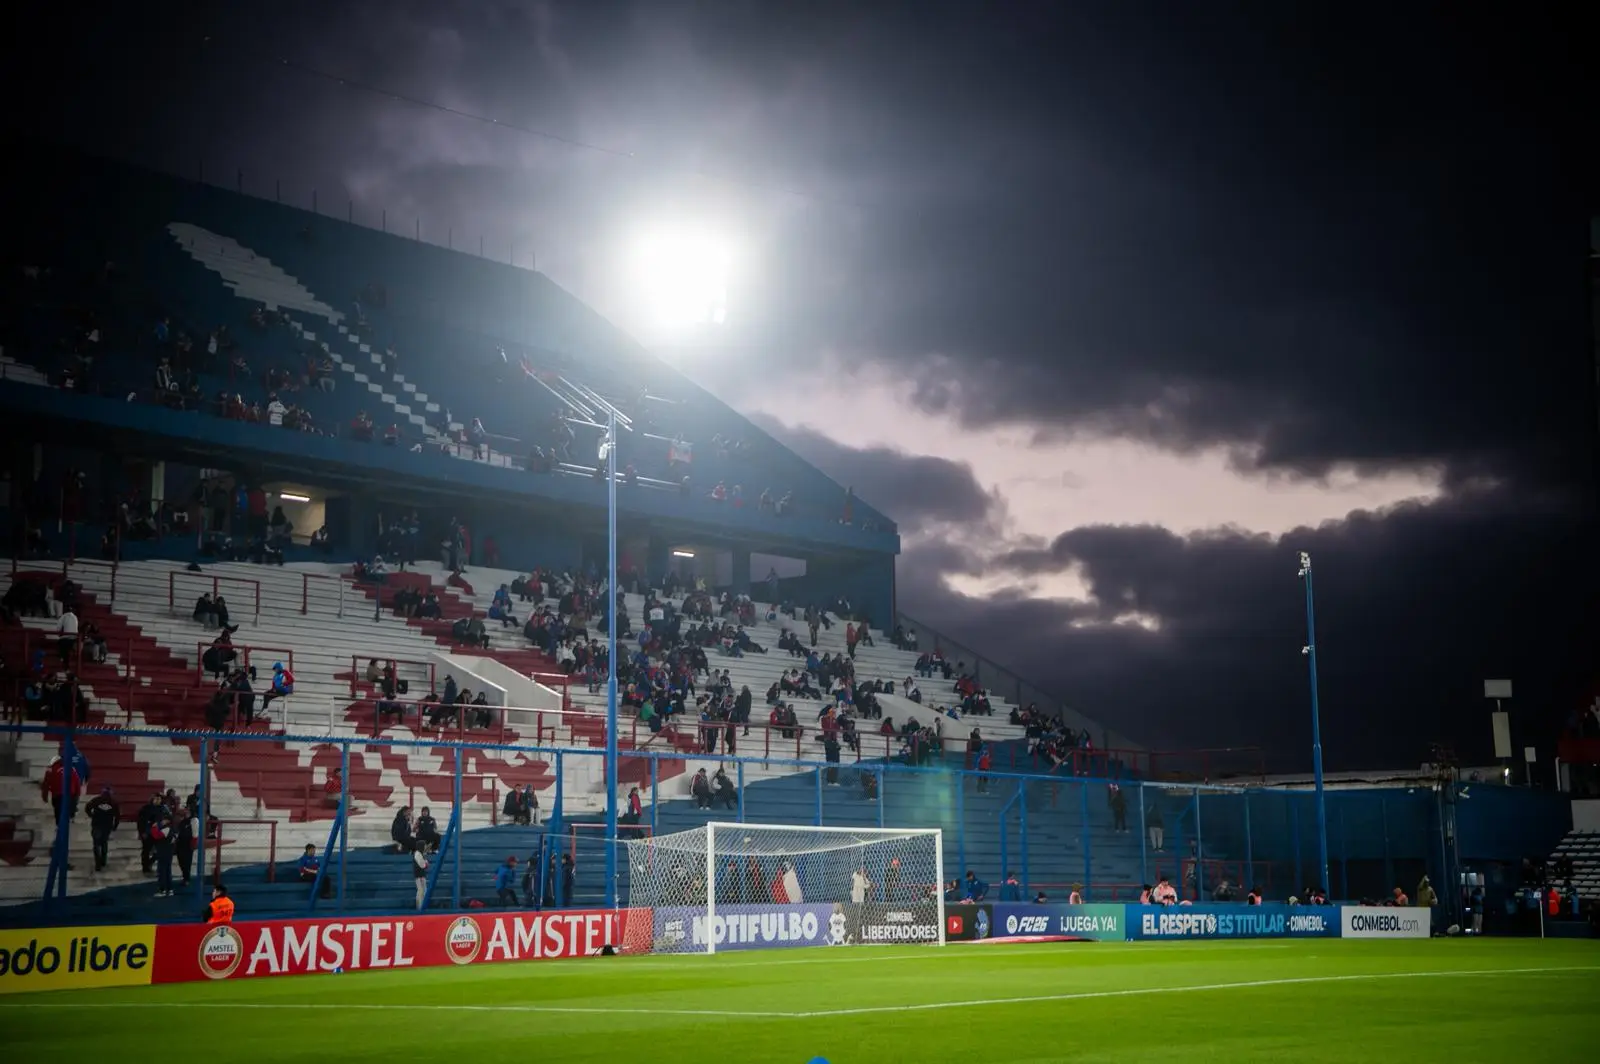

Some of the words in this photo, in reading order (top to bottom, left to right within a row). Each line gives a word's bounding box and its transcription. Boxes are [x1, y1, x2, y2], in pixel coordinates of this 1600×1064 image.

[693, 912, 818, 945] NOTIFULBO
[862, 924, 937, 939] LIBERTADORES
[1060, 916, 1099, 932] ¡JUEGA
[1100, 916, 1117, 932] YA!
[1142, 914, 1159, 935] EL
[1218, 915, 1234, 934] ES
[1235, 915, 1284, 934] TITULAR
[1290, 915, 1324, 932] CONMEBOL
[1351, 915, 1419, 932] CONMEBOL.com
[68, 937, 148, 972] libre
[208, 944, 234, 953] AMSTEL
